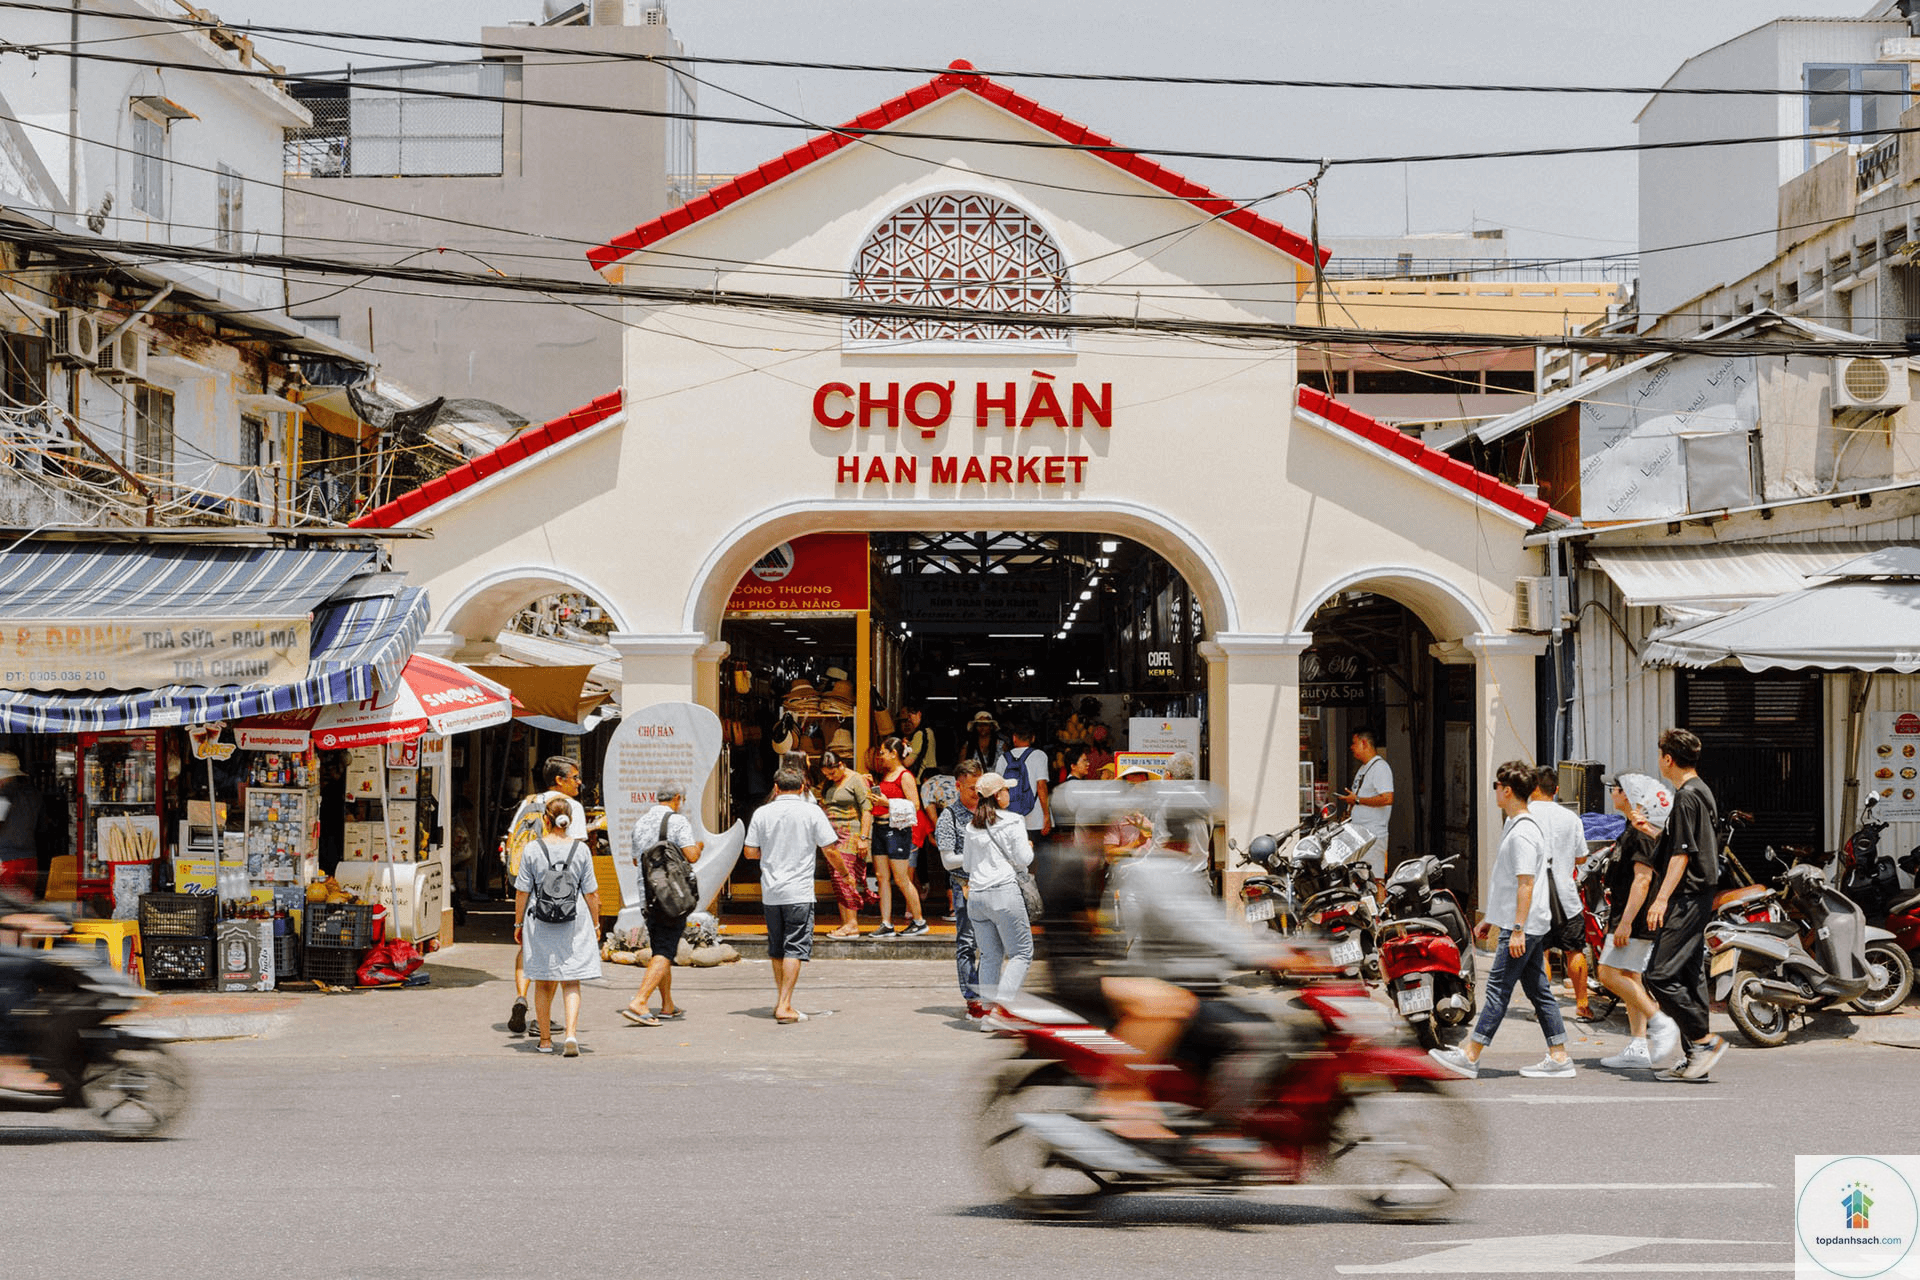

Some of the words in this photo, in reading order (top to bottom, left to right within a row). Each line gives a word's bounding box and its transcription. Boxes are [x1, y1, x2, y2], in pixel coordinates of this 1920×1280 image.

[812, 380, 955, 439] CHỢ
[976, 369, 1113, 428] HÀN
[837, 455, 917, 484] HAN
[931, 455, 1089, 484] MARKET
[733, 585, 773, 594] CÔNG
[778, 585, 833, 594] THƯƠNG
[748, 597, 777, 609] PHỐ
[779, 597, 799, 609] ĐÀ
[142, 628, 175, 649] TRÀ
[181, 627, 215, 648] SỮA
[232, 631, 265, 648] RAU
[85, 671, 106, 681] 210
[174, 659, 205, 678] TRÀ
[211, 660, 269, 678] CHANH
[1343, 685, 1365, 701] Spa
